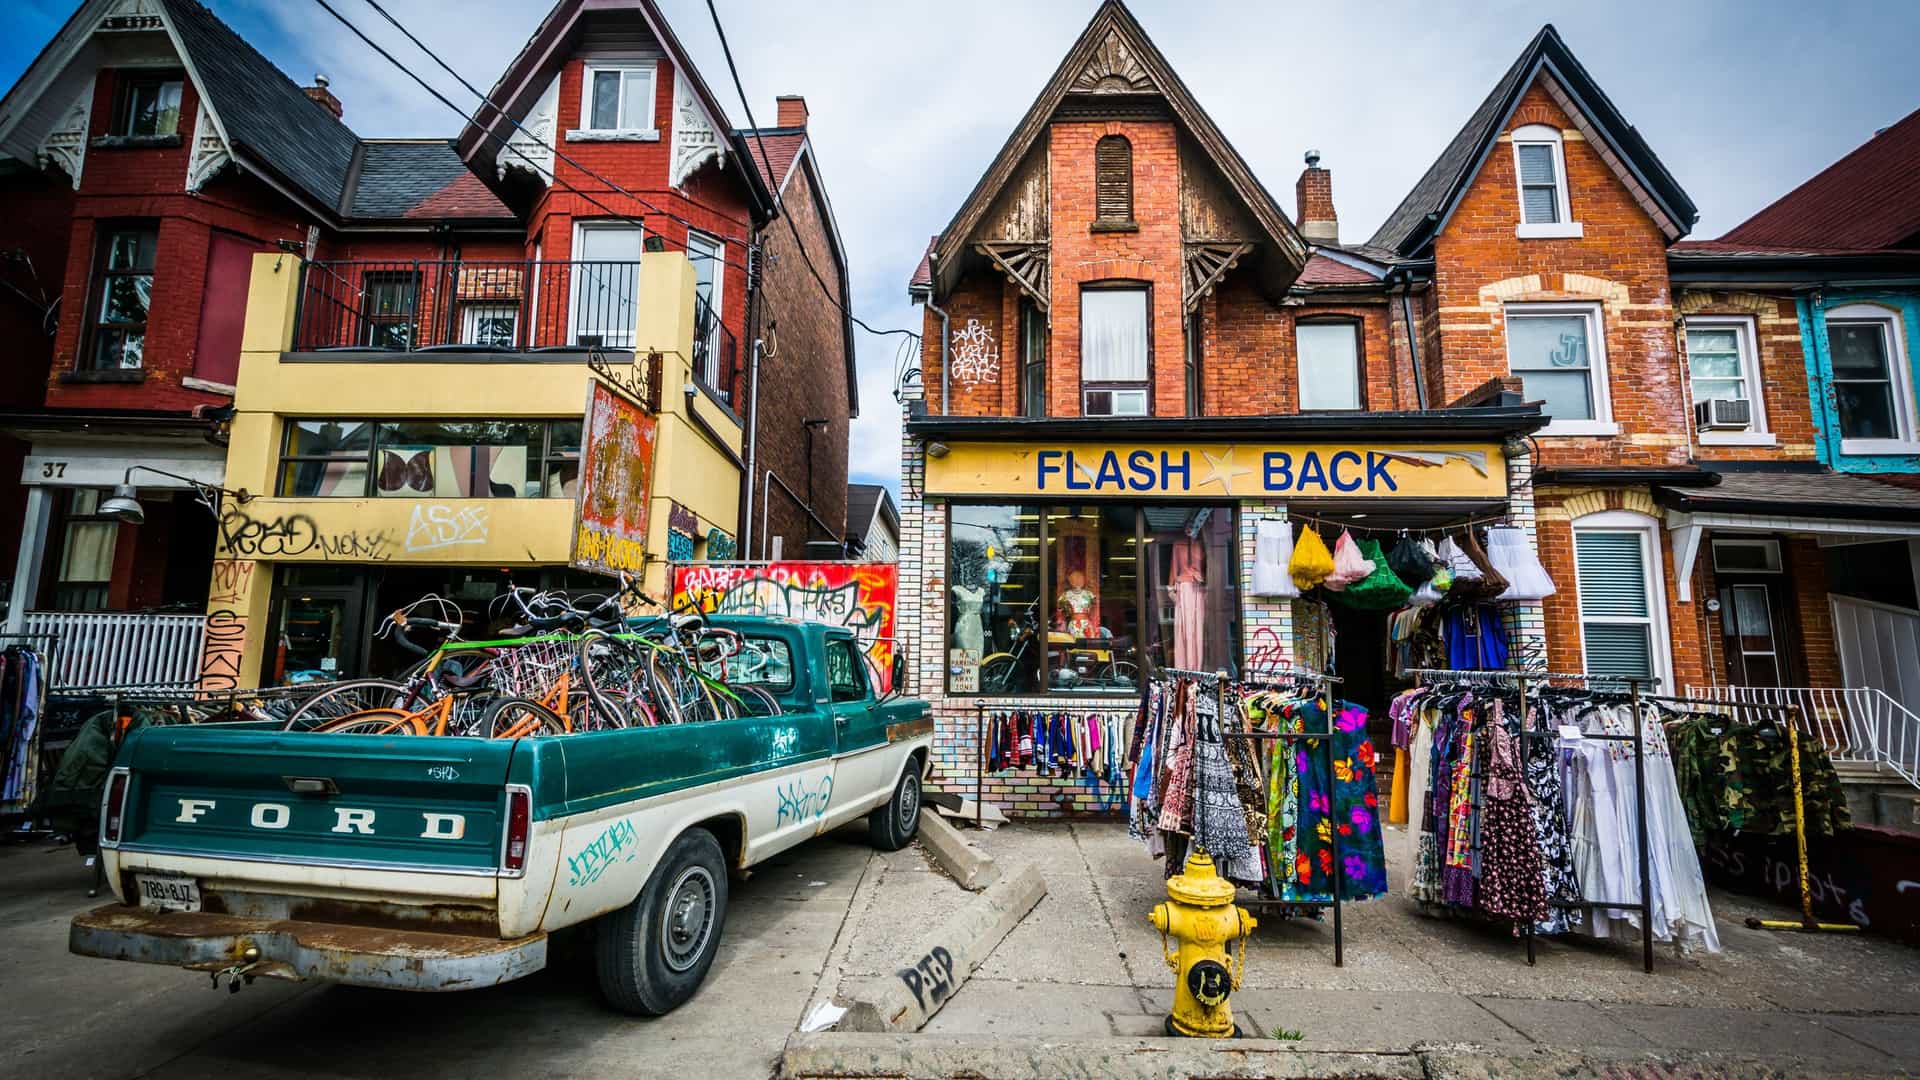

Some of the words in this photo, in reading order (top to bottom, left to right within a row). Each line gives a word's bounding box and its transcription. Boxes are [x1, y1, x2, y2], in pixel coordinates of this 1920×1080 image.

[43, 462, 68, 478] 37
[1037, 450, 1190, 490] FLASH
[1263, 450, 1398, 491] BACK
[175, 799, 466, 840] FORD
